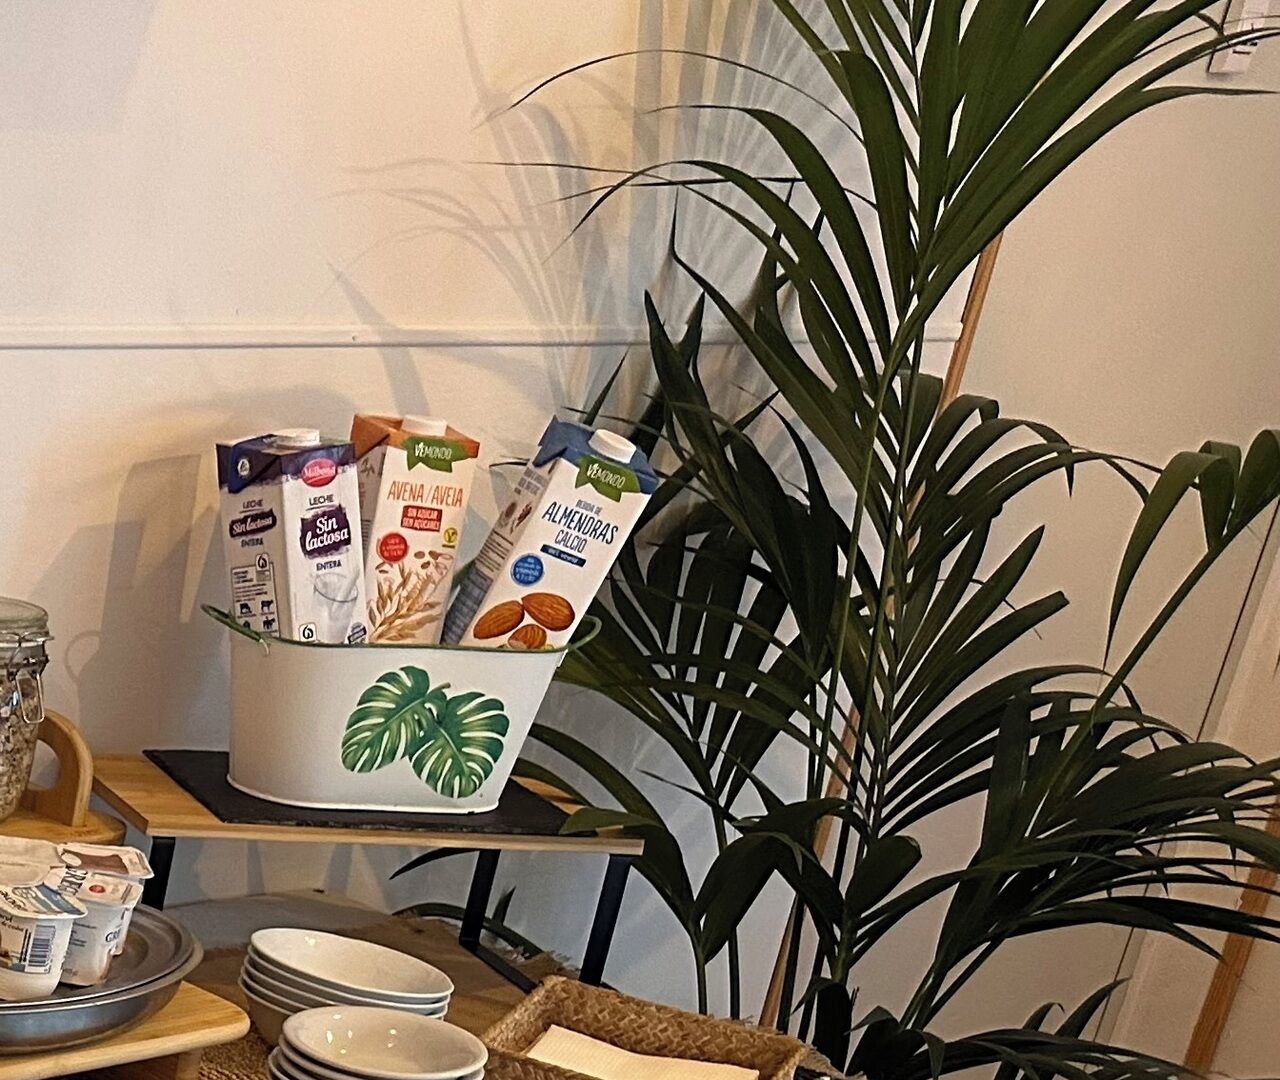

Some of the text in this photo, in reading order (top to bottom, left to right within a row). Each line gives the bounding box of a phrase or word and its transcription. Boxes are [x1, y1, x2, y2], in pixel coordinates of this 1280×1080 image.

[309, 494, 334, 507] LECHE
[387, 480, 425, 502] AVENA
[431, 485, 464, 508] AVEIA
[316, 516, 338, 534] Sin
[541, 501, 619, 545] ALMENDRAS
[305, 527, 349, 551] lactosa
[555, 529, 588, 554] CALCIO
